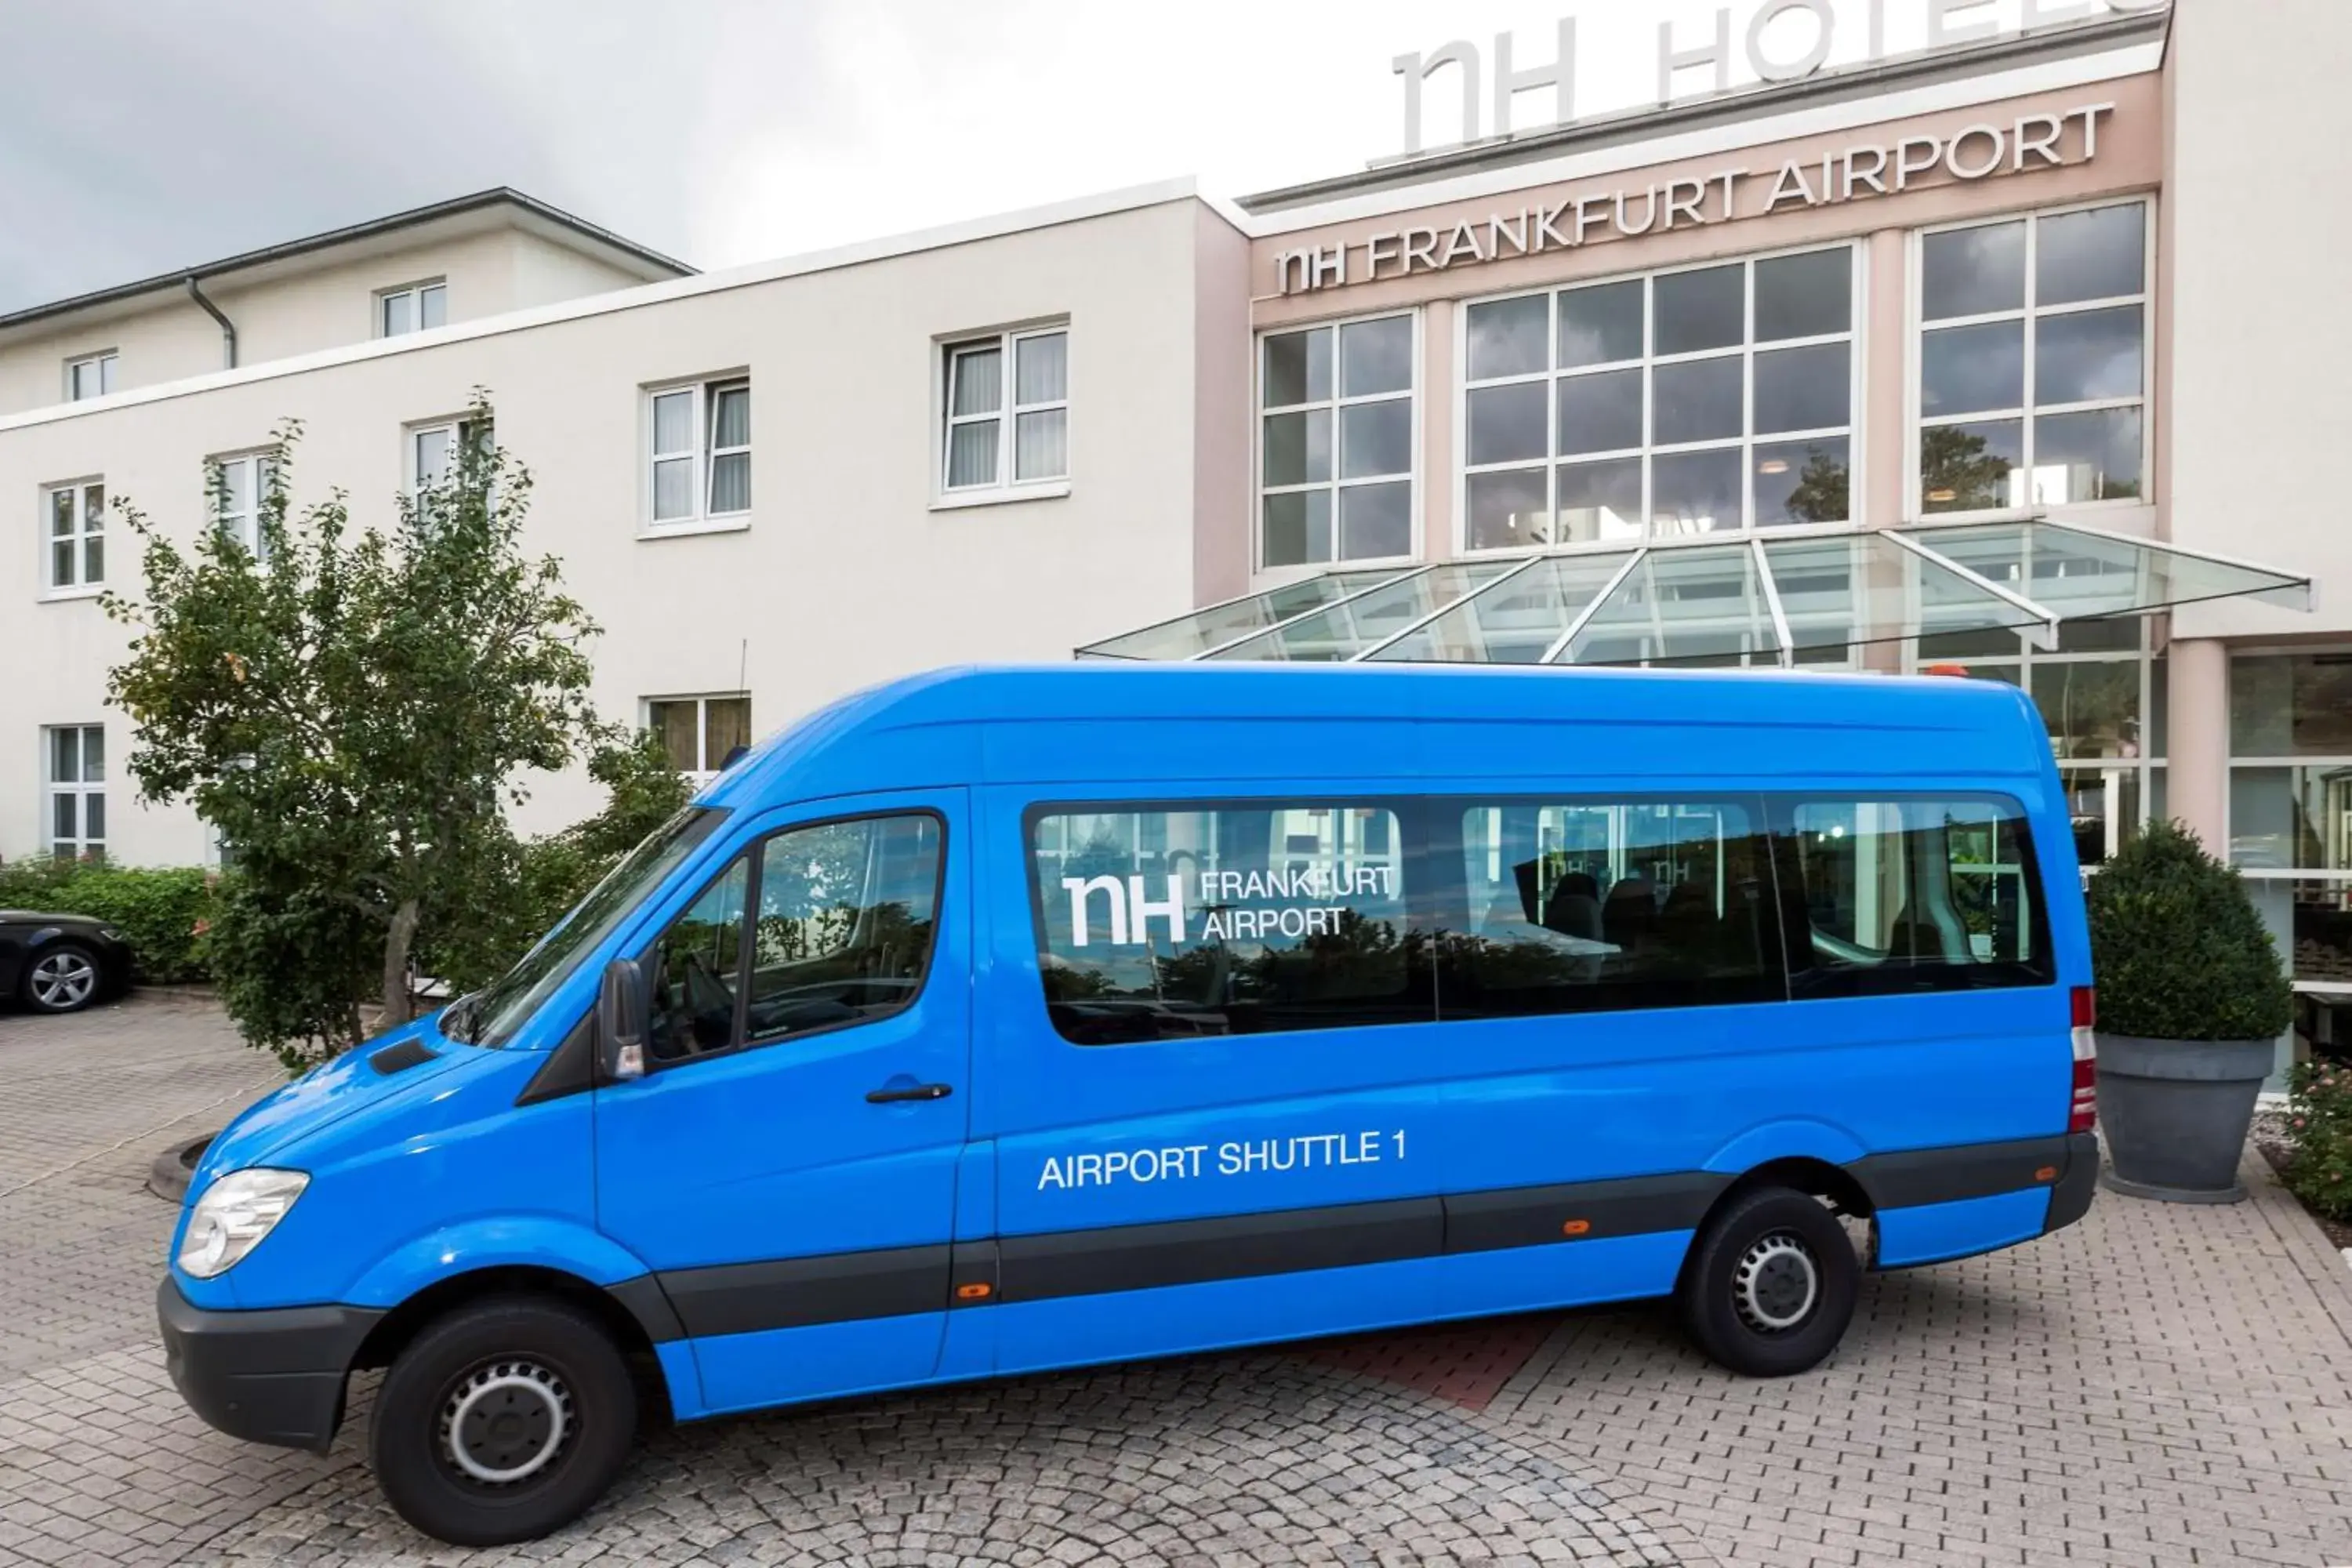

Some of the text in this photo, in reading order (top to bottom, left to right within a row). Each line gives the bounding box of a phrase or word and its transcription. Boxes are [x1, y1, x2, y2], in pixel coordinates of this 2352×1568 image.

[1367, 167, 1750, 281] FRANKFURT
[1763, 101, 2115, 214] AIRPORT
[1200, 866, 1395, 900] FRANKFURT
[1202, 906, 1347, 941] AIRPORT
[1036, 1129, 1406, 1190] AIRPORT SHUTTLE 1
